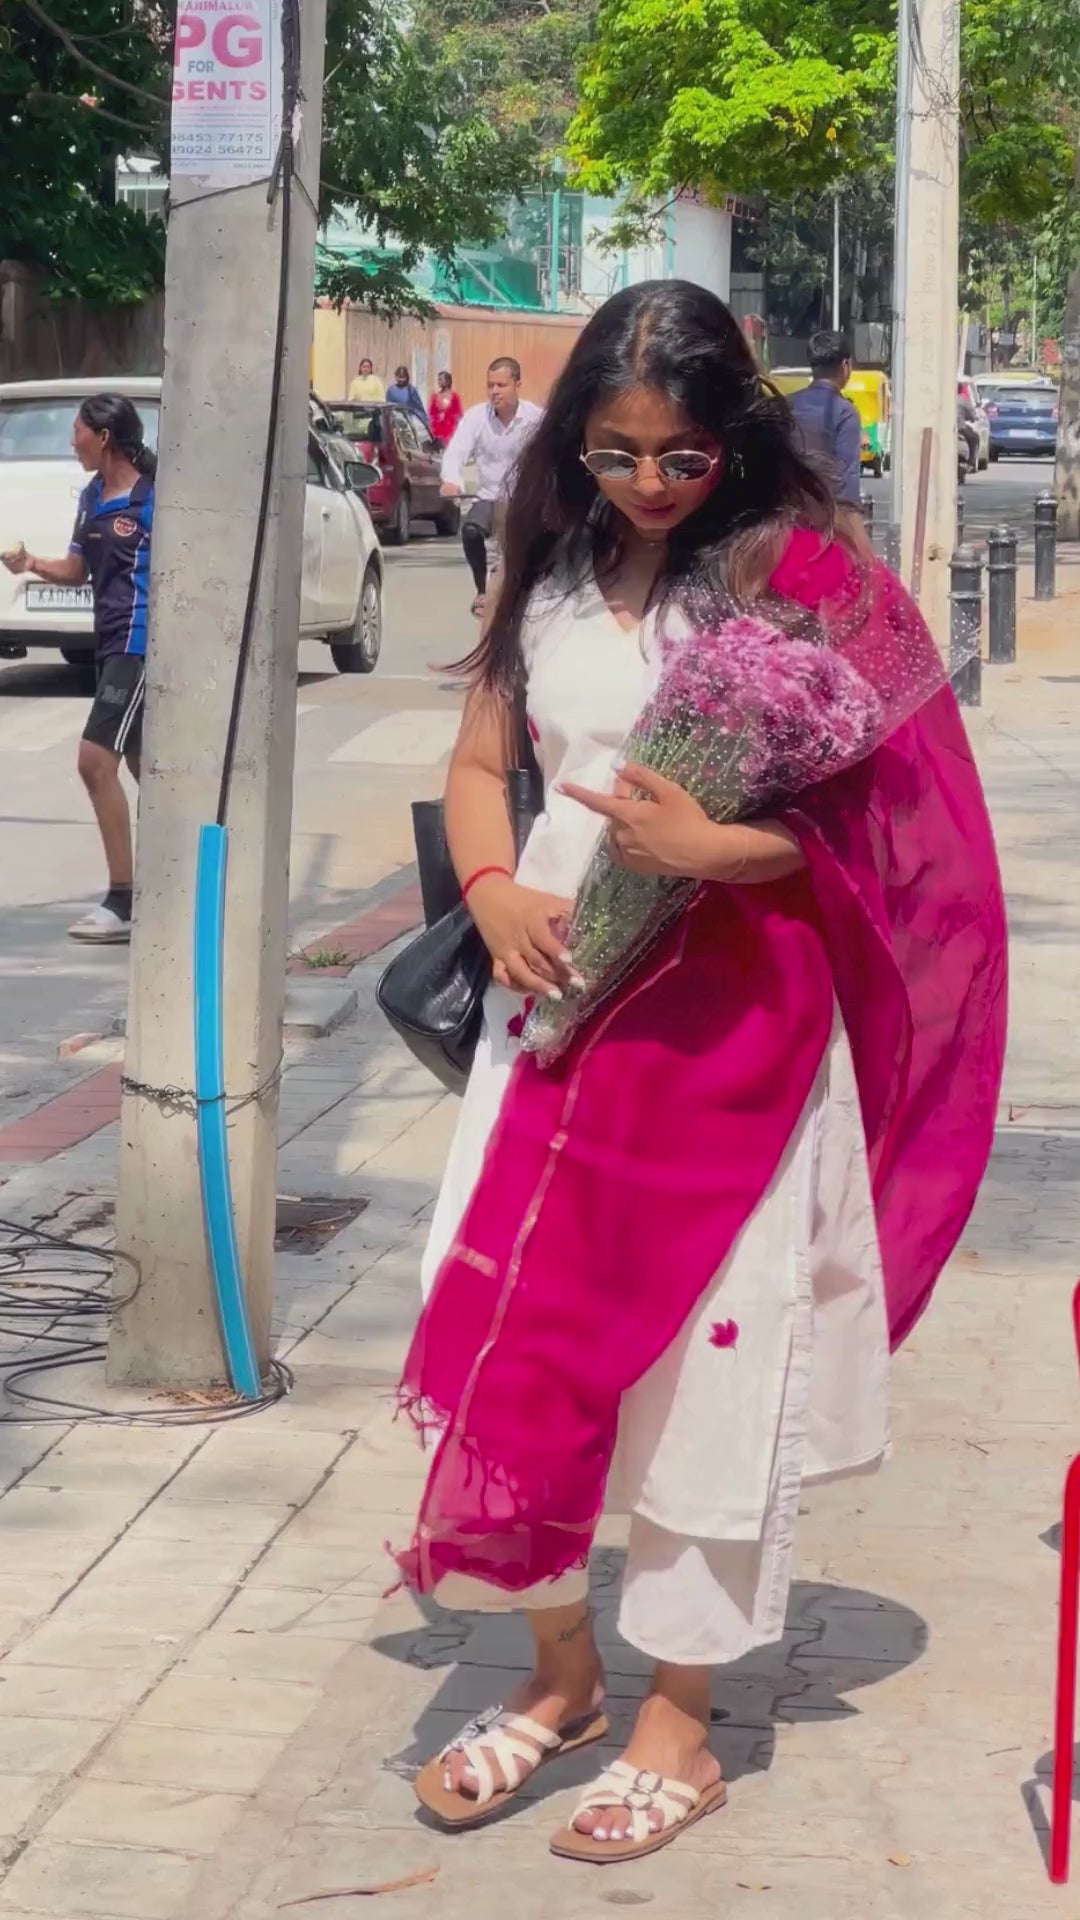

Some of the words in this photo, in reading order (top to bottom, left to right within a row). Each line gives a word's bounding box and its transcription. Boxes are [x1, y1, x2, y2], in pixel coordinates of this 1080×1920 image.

[174, 14, 263, 68] PG
[188, 61, 215, 73] FOR
[172, 80, 267, 101] GENTS
[217, 133, 264, 142] 77175
[217, 145, 264, 154] 56475
